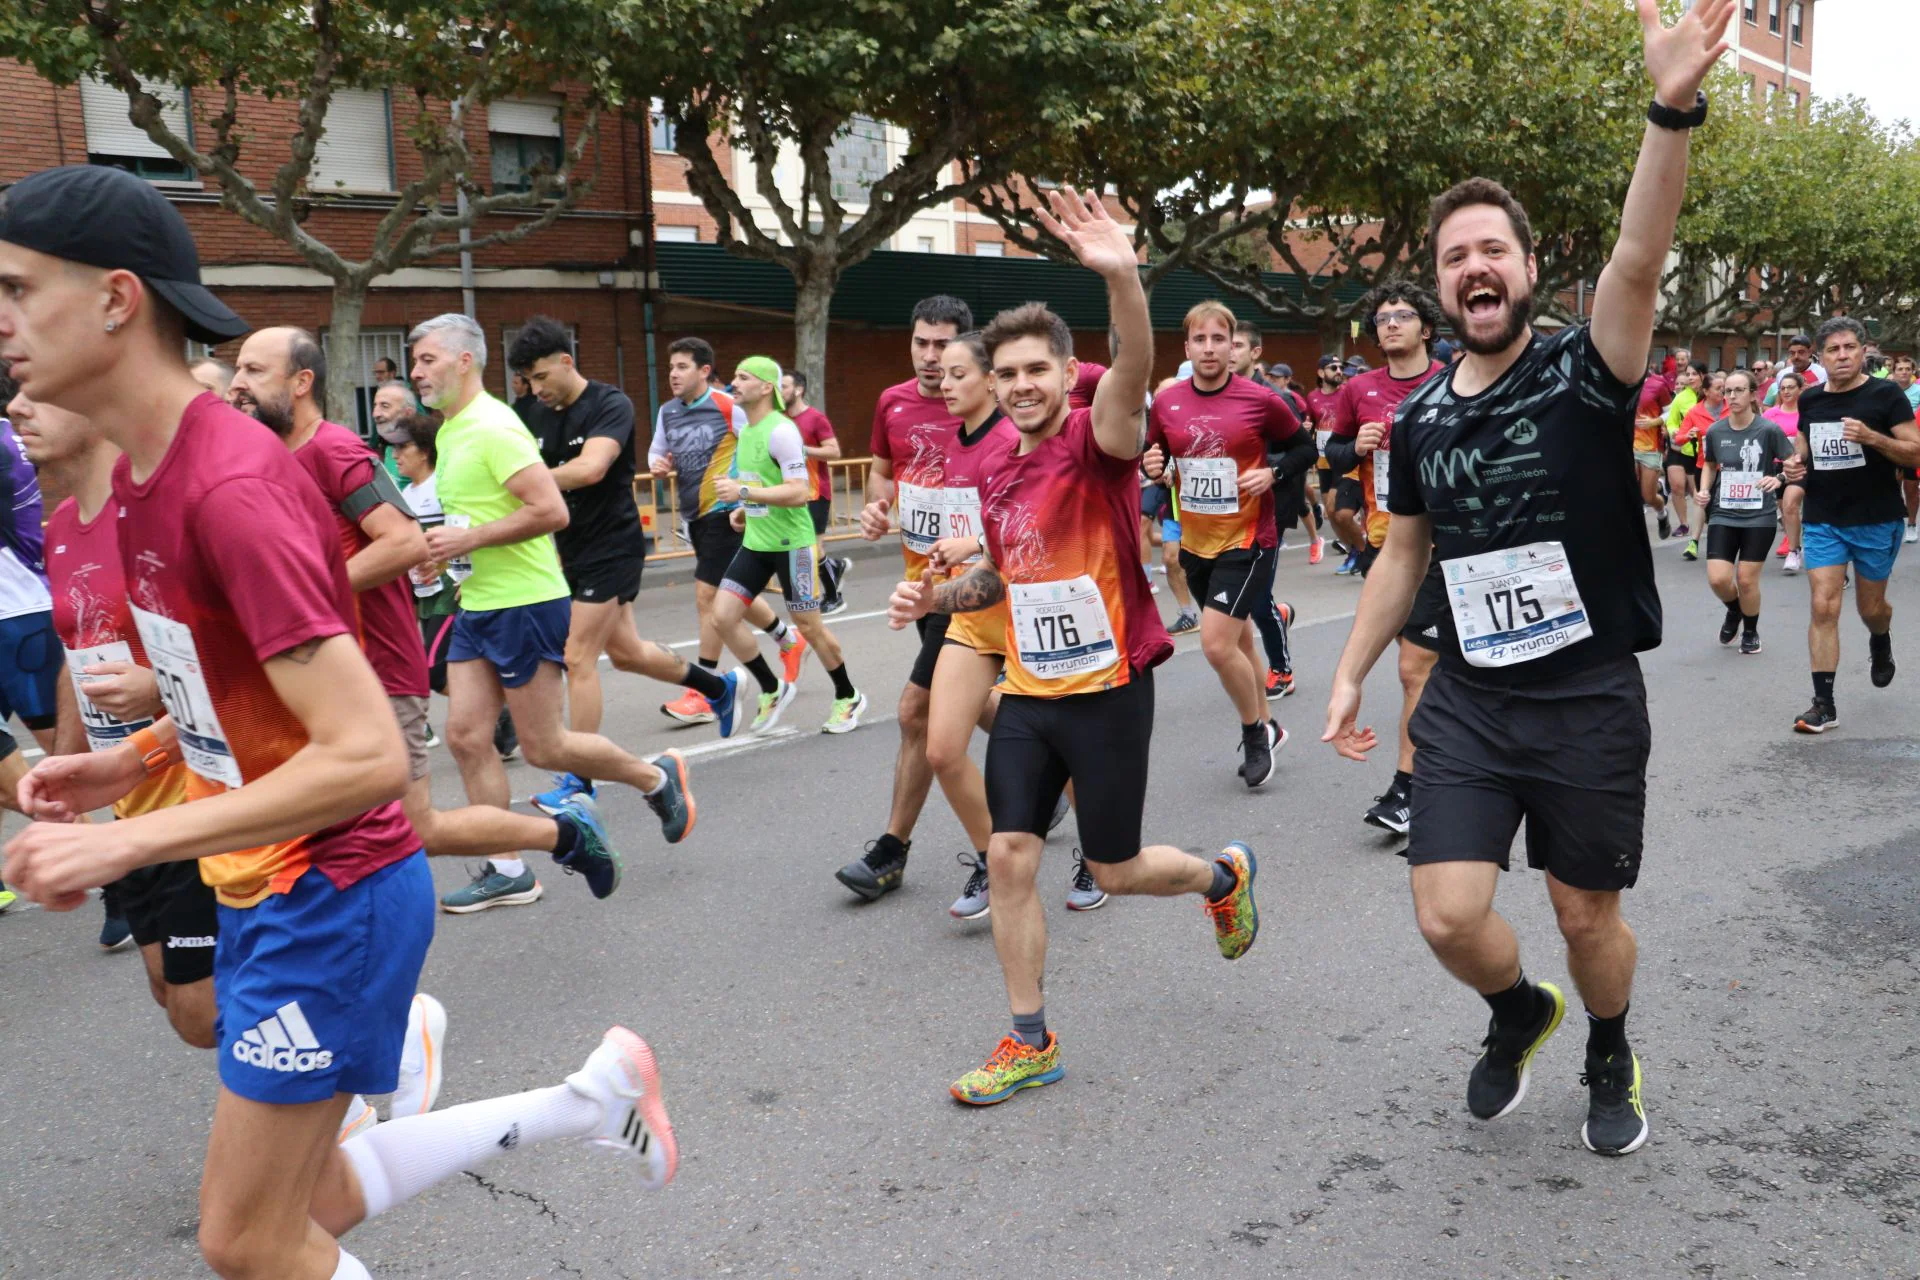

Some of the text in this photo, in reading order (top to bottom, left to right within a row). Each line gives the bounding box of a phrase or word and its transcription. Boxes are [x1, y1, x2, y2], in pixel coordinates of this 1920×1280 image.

[1821, 438, 1849, 456] 496
[1482, 466, 1513, 477] media
[1190, 477, 1222, 498] 720
[1729, 484, 1753, 499] 897
[911, 508, 941, 537] 178
[1485, 584, 1545, 632] 175
[1034, 613, 1081, 651] 176
[1511, 630, 1569, 654] HYUNDAI
[1051, 654, 1100, 672] HYUNDAI
[232, 1039, 334, 1073] adidas
